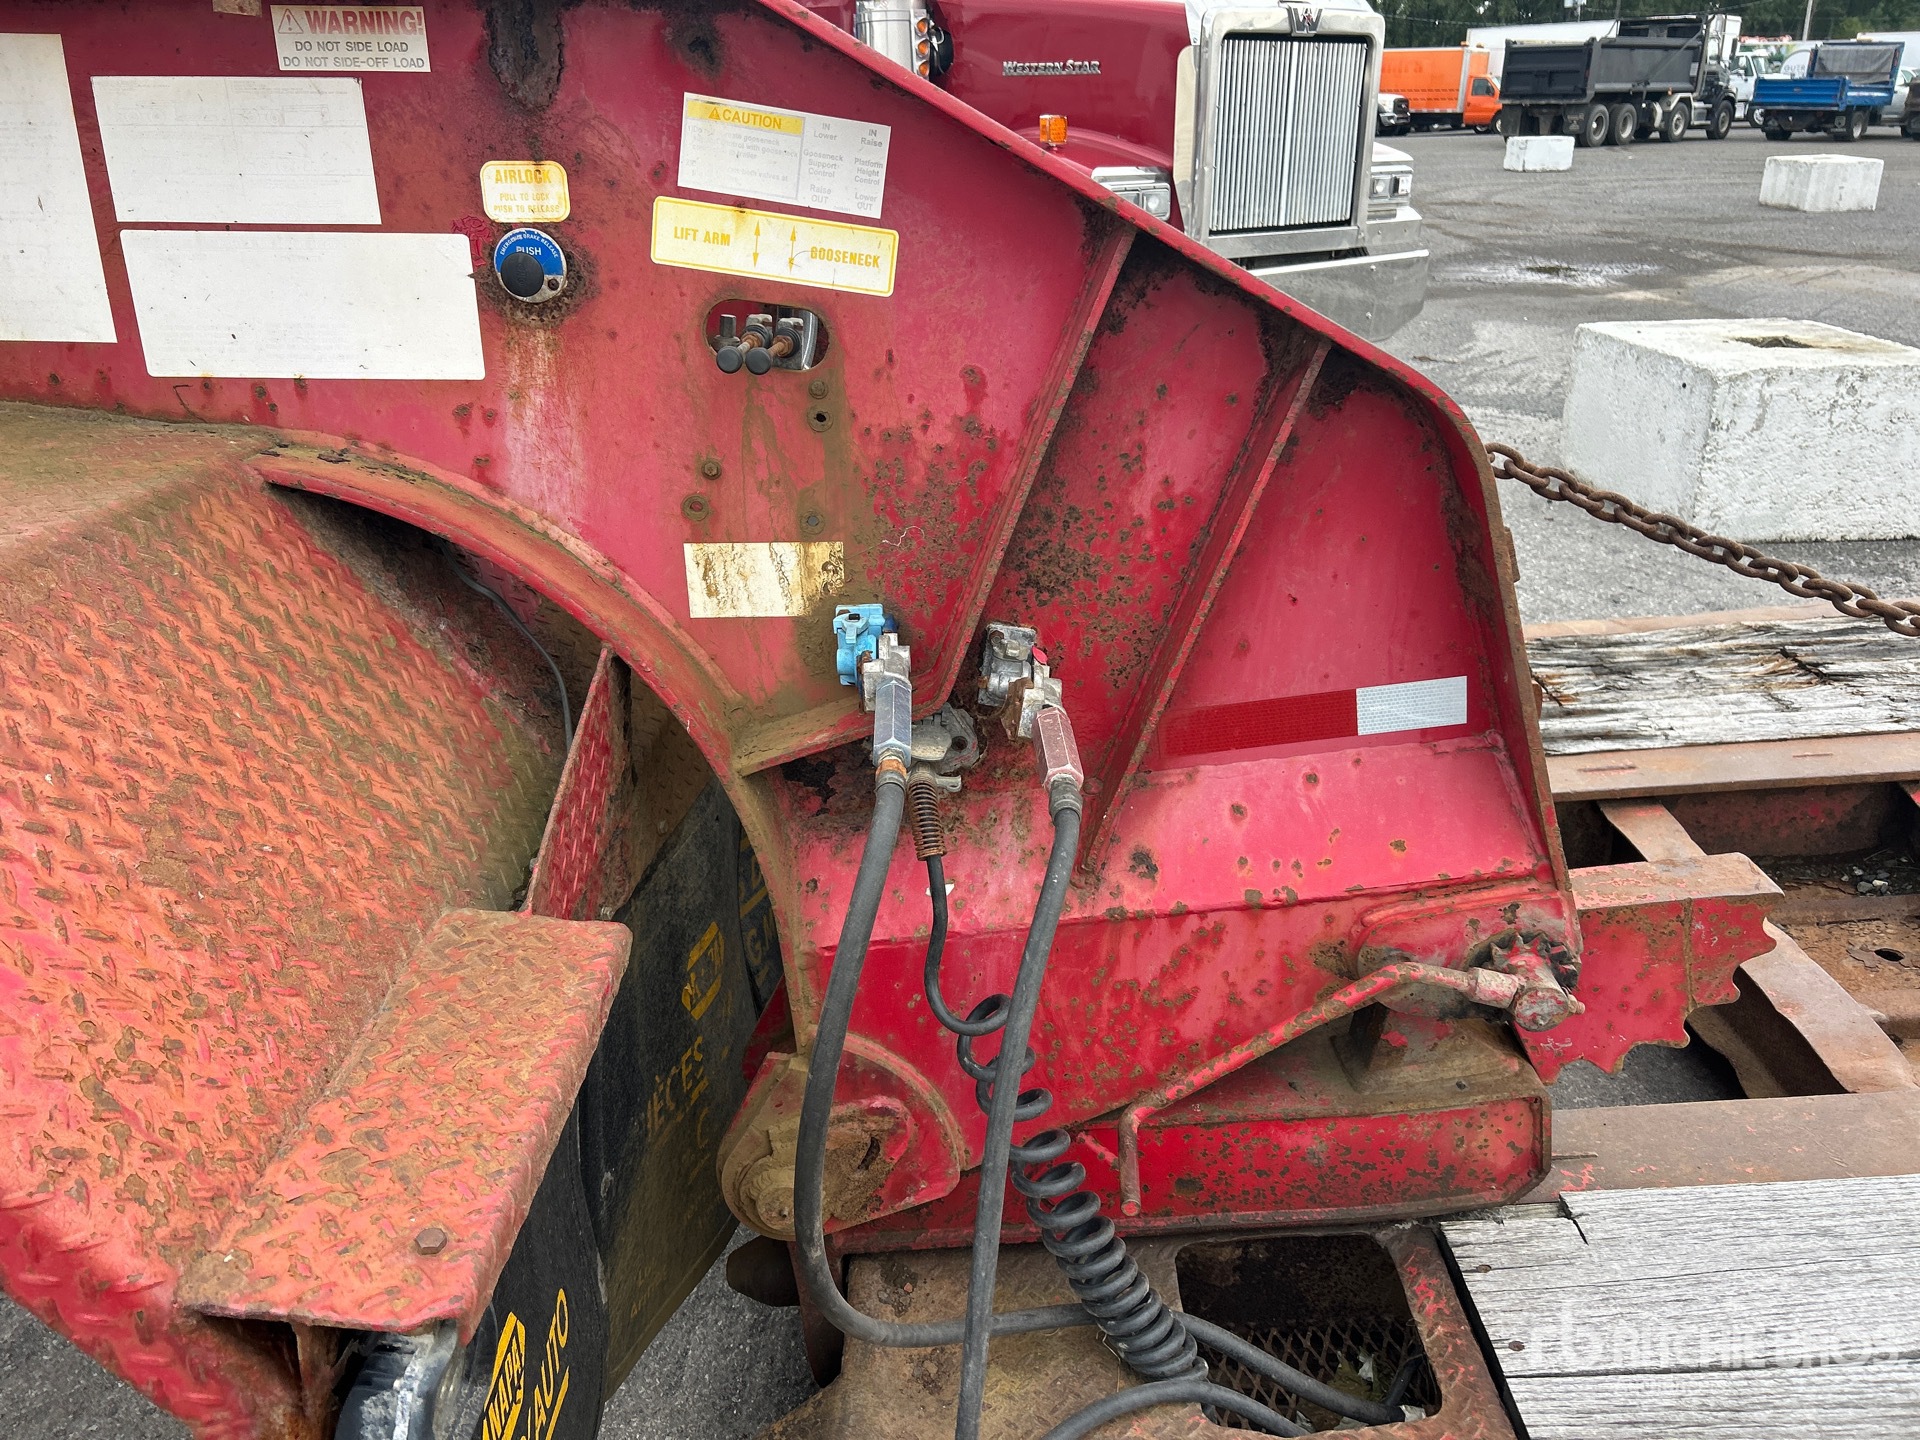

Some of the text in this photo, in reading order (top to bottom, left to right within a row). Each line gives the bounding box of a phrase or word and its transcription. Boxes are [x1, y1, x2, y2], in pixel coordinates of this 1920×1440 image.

[304, 10, 425, 35] WARNING!
[295, 41, 409, 53] DO NOT SIDE LOAD
[283, 56, 425, 68] DO NOT SIDE-OFF LOAD
[722, 109, 782, 129] CAUTION
[822, 123, 831, 131] IN
[813, 130, 838, 141] Lower
[869, 129, 878, 137] IN
[861, 137, 883, 148] Raise
[803, 149, 843, 161] Gooseneck
[808, 158, 837, 169] Support
[854, 157, 884, 169] Platform
[495, 169, 552, 185] AIRLOCK
[808, 167, 835, 178] Control
[856, 167, 879, 177] Height
[854, 175, 880, 186] Control
[809, 183, 832, 194] Raise
[500, 192, 550, 202] PULL TO LOCK
[811, 195, 829, 204] OUT
[855, 192, 878, 202] Lower
[516, 204, 525, 213] TO
[527, 204, 560, 213] RELEASE
[857, 202, 873, 211] OUT
[673, 226, 731, 246] LIFT ARM
[523, 233, 541, 242] BRAKE
[541, 238, 559, 259] RELEASE
[810, 246, 881, 268] GOOSENECK
